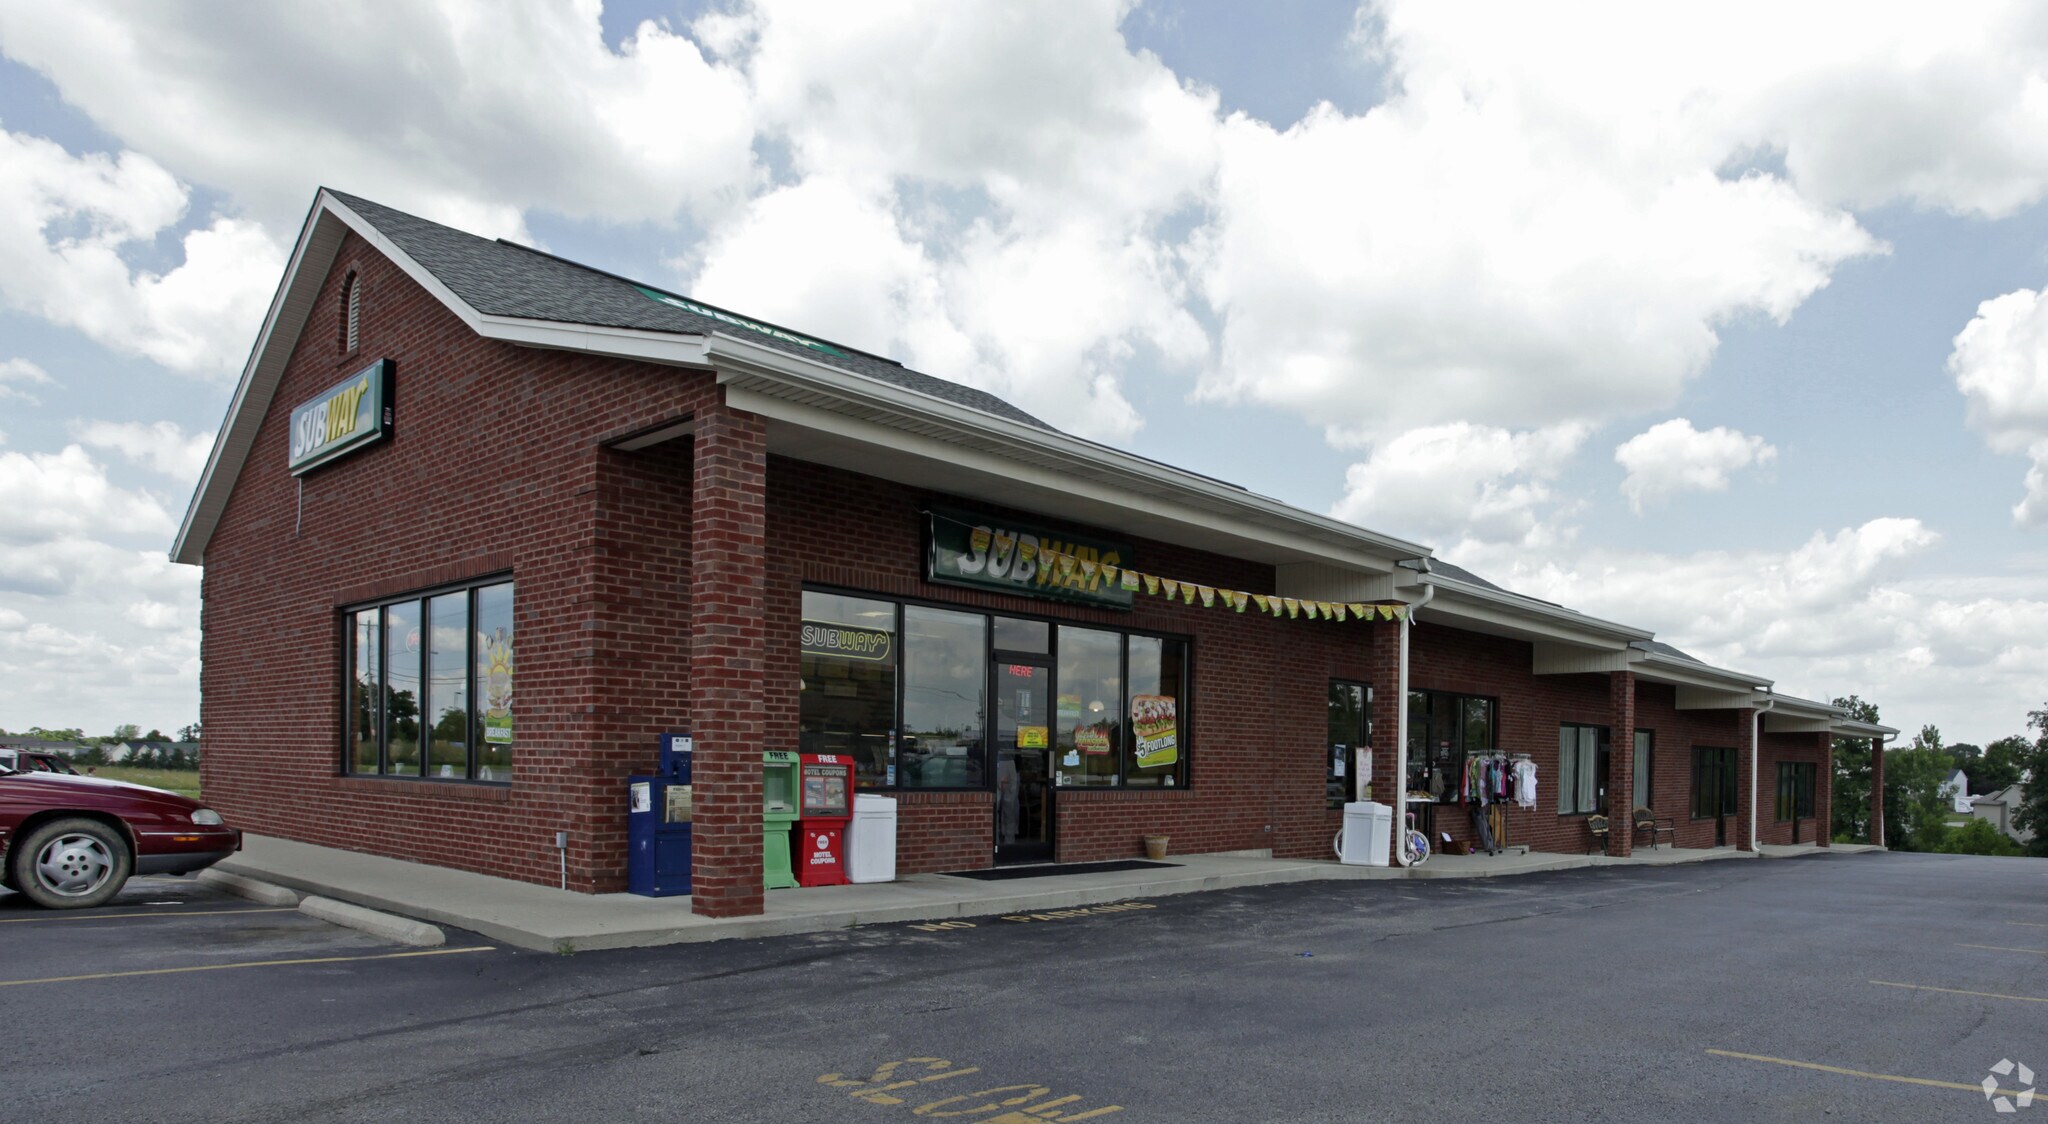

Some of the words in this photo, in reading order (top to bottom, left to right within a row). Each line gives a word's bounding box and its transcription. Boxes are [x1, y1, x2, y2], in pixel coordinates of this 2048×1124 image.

[295, 378, 368, 459] SUBWAY
[957, 525, 1121, 593] SUBWAY
[801, 625, 887, 652] SUBWAY
[1008, 665, 1033, 678] HERE
[1147, 735, 1175, 752] FOOTLONG
[769, 752, 789, 760] FREE
[817, 754, 837, 763] FREE
[821, 769, 847, 777] COUPONS
